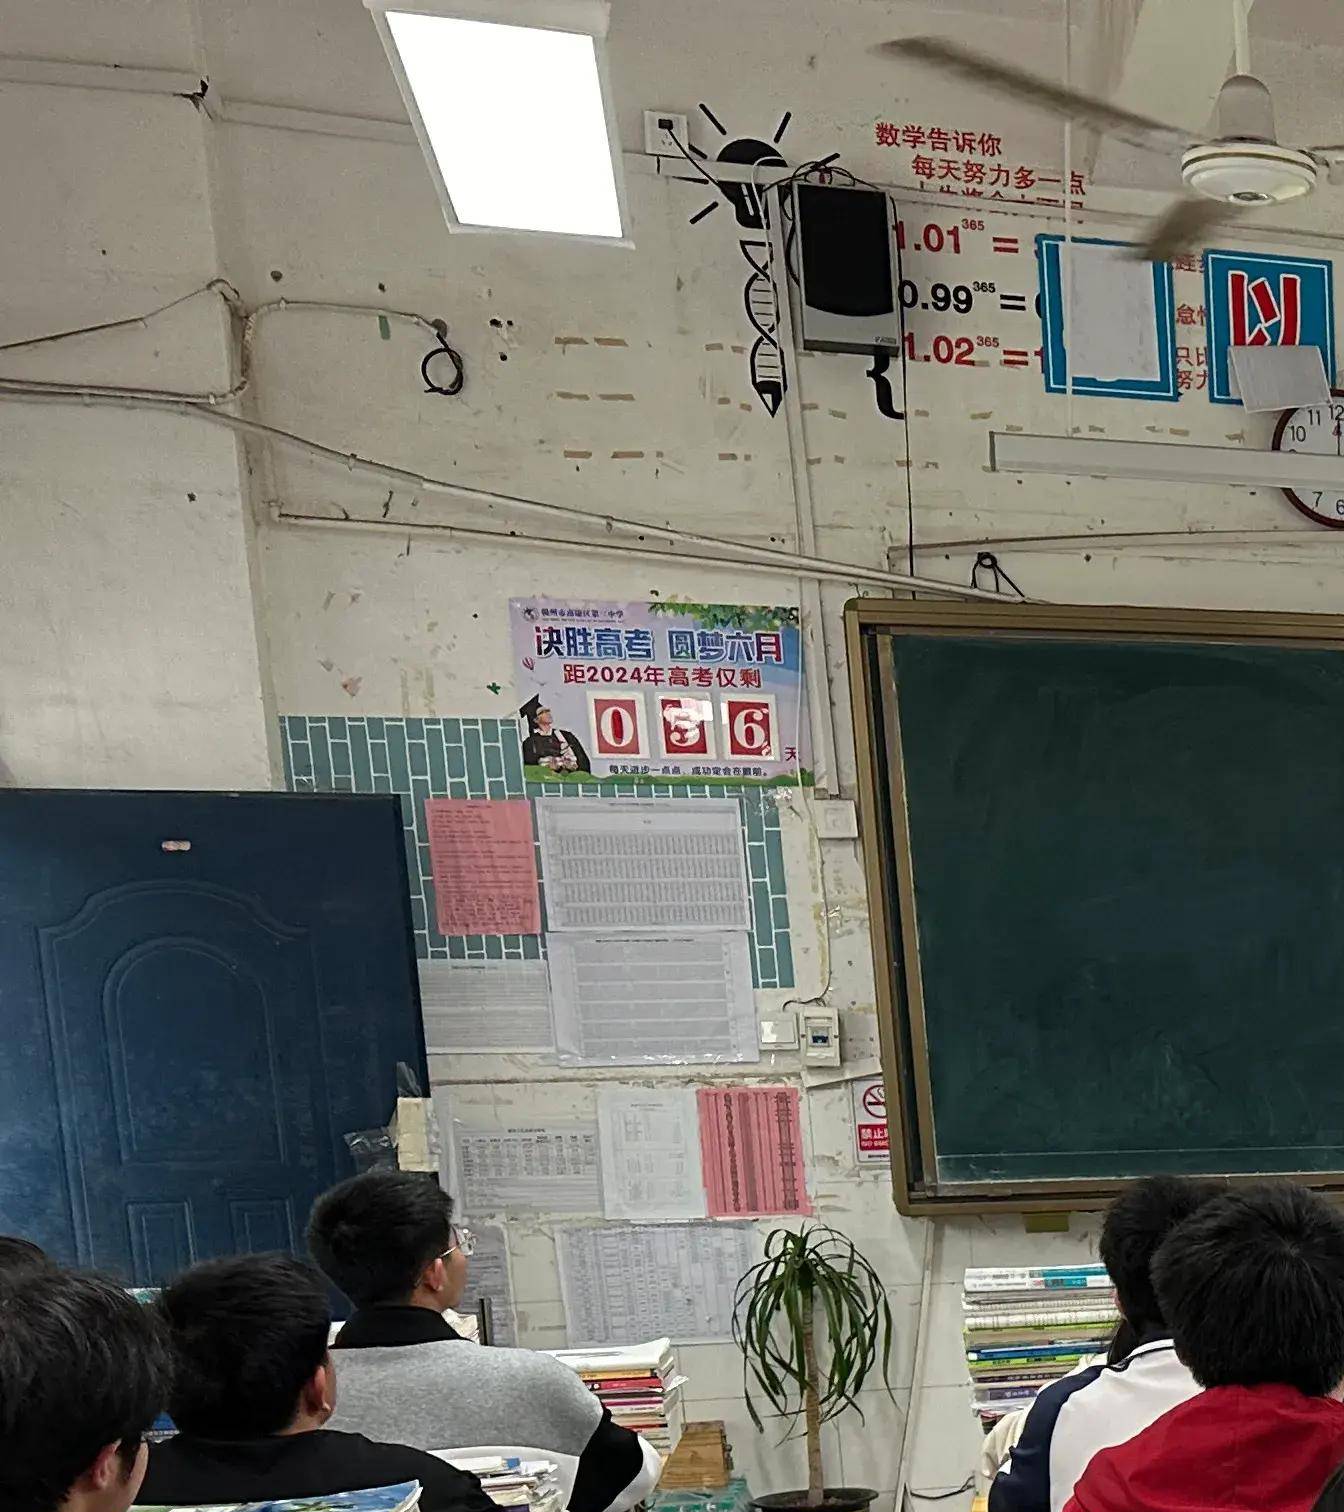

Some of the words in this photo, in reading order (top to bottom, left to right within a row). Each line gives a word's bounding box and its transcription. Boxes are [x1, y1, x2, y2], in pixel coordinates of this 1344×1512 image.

[876, 122, 1002, 158] 数学告诉你
[912, 154, 1087, 196] 每天努力多一点
[1307, 409, 1322, 427] 11
[1328, 404, 1344, 421] 12
[1290, 426, 1307, 443] 10
[1312, 492, 1323, 508] 7
[534, 625, 654, 661] 决胜高考
[667, 629, 785, 665] 圆梦六月
[563, 664, 762, 689] 距2024年高考仅剩
